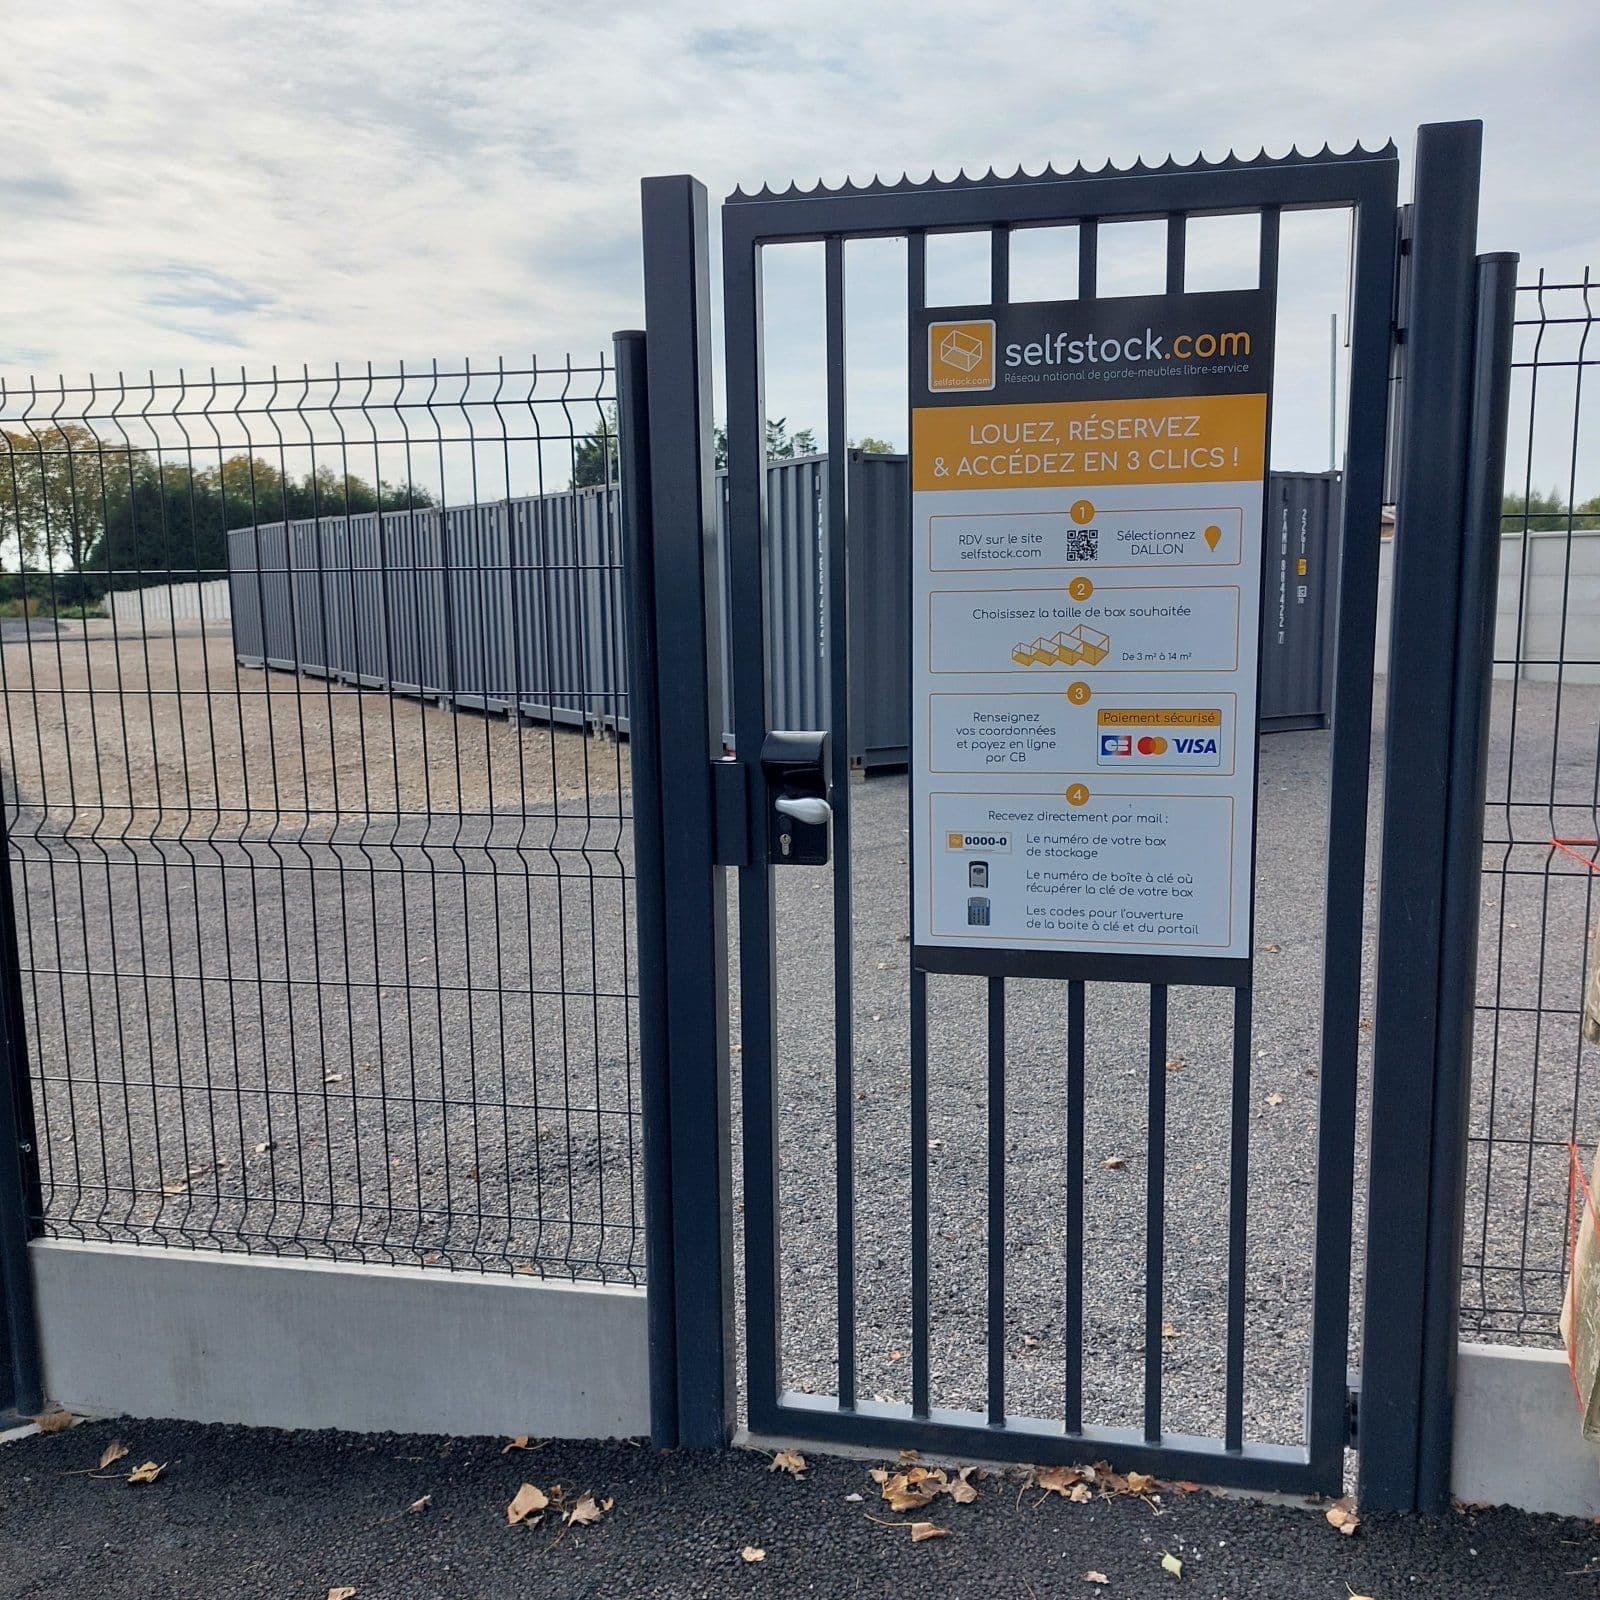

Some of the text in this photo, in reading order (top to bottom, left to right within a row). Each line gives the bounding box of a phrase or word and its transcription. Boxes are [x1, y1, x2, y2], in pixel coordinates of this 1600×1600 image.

[1005, 328, 1250, 366] selfstock.com
[1005, 363, 1249, 383] Réseau national de garde-meubles libre-service
[934, 377, 991, 387] selfstock.com
[970, 413, 1200, 446] LOUEZ, RÉSERVEZ
[934, 446, 1238, 476] & ACCÉDEZ EN 3 CLICS !
[1080, 507, 1085, 518] 1
[959, 532, 1043, 546] RDV sur le site
[1117, 529, 1196, 541] Sélectionnez
[960, 547, 1042, 561] selfstock.com
[1131, 543, 1184, 555] DALLON
[1077, 584, 1085, 595] 2
[973, 605, 1191, 620] Choisissez la taille de box souhaitée
[1122, 651, 1135, 661] De
[1136, 651, 1143, 661] 3
[1158, 651, 1166, 661] à
[1168, 651, 1177, 660] 14
[1075, 688, 1083, 699] 3
[973, 712, 1040, 725] Renseignez
[1104, 712, 1215, 723] Paiement sécurisé
[956, 725, 1057, 736] vos coordonnées
[957, 739, 1057, 752] et payez en ligne
[1172, 738, 1217, 754] VISA
[986, 752, 1026, 763] par CB
[1073, 789, 1082, 800] 4
[988, 811, 1034, 822] Recevez
[1037, 811, 1108, 823] directement
[1111, 813, 1133, 824] par
[1136, 812, 1163, 824] mail
[965, 836, 1007, 846] 0000-0
[1026, 833, 1167, 846] Le numéro de votre box
[1026, 847, 1098, 860] de stockage
[1026, 870, 1194, 885] Le numéro de boîte à clé où
[1026, 883, 1194, 897] récupérer la clé de votre box
[1026, 907, 1184, 921] Les codes pour l'ouverture
[1026, 918, 1041, 929] de
[1044, 918, 1055, 929] la
[1092, 919, 1100, 930] à
[1103, 920, 1121, 931] clé
[1122, 921, 1136, 932] et
[1138, 922, 1155, 933] du
[1157, 922, 1200, 935] portail
